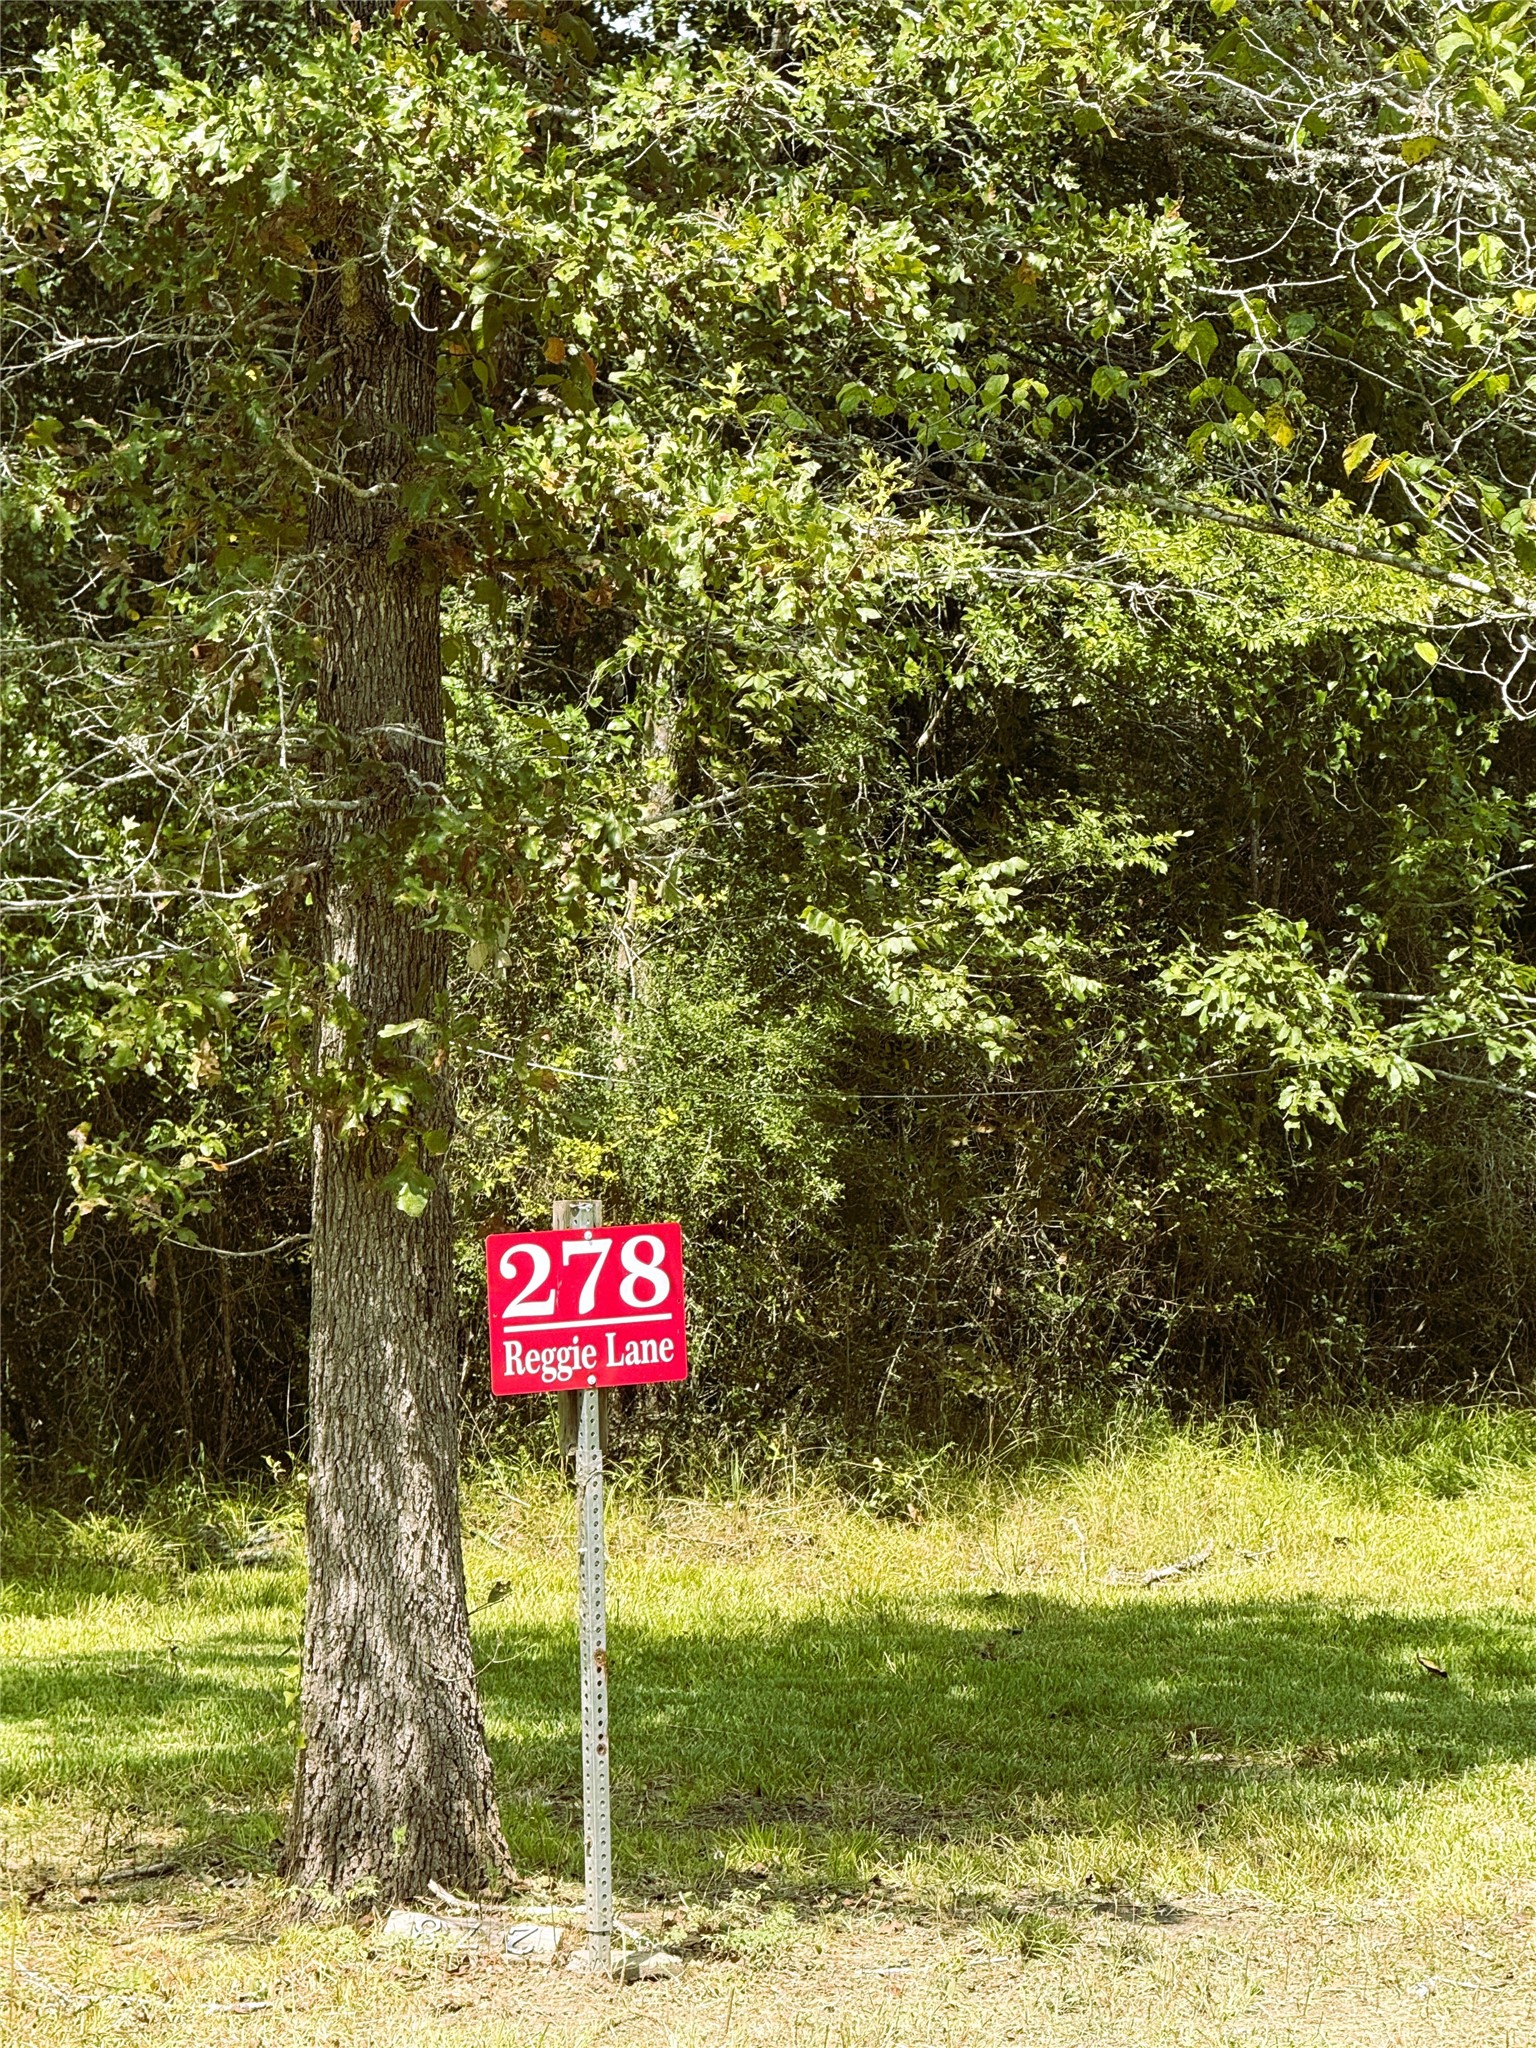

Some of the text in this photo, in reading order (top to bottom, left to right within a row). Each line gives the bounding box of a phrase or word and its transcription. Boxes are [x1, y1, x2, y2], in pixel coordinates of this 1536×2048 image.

[500, 1235, 670, 1319] 278
[503, 1332, 674, 1383] Reggie Lane
